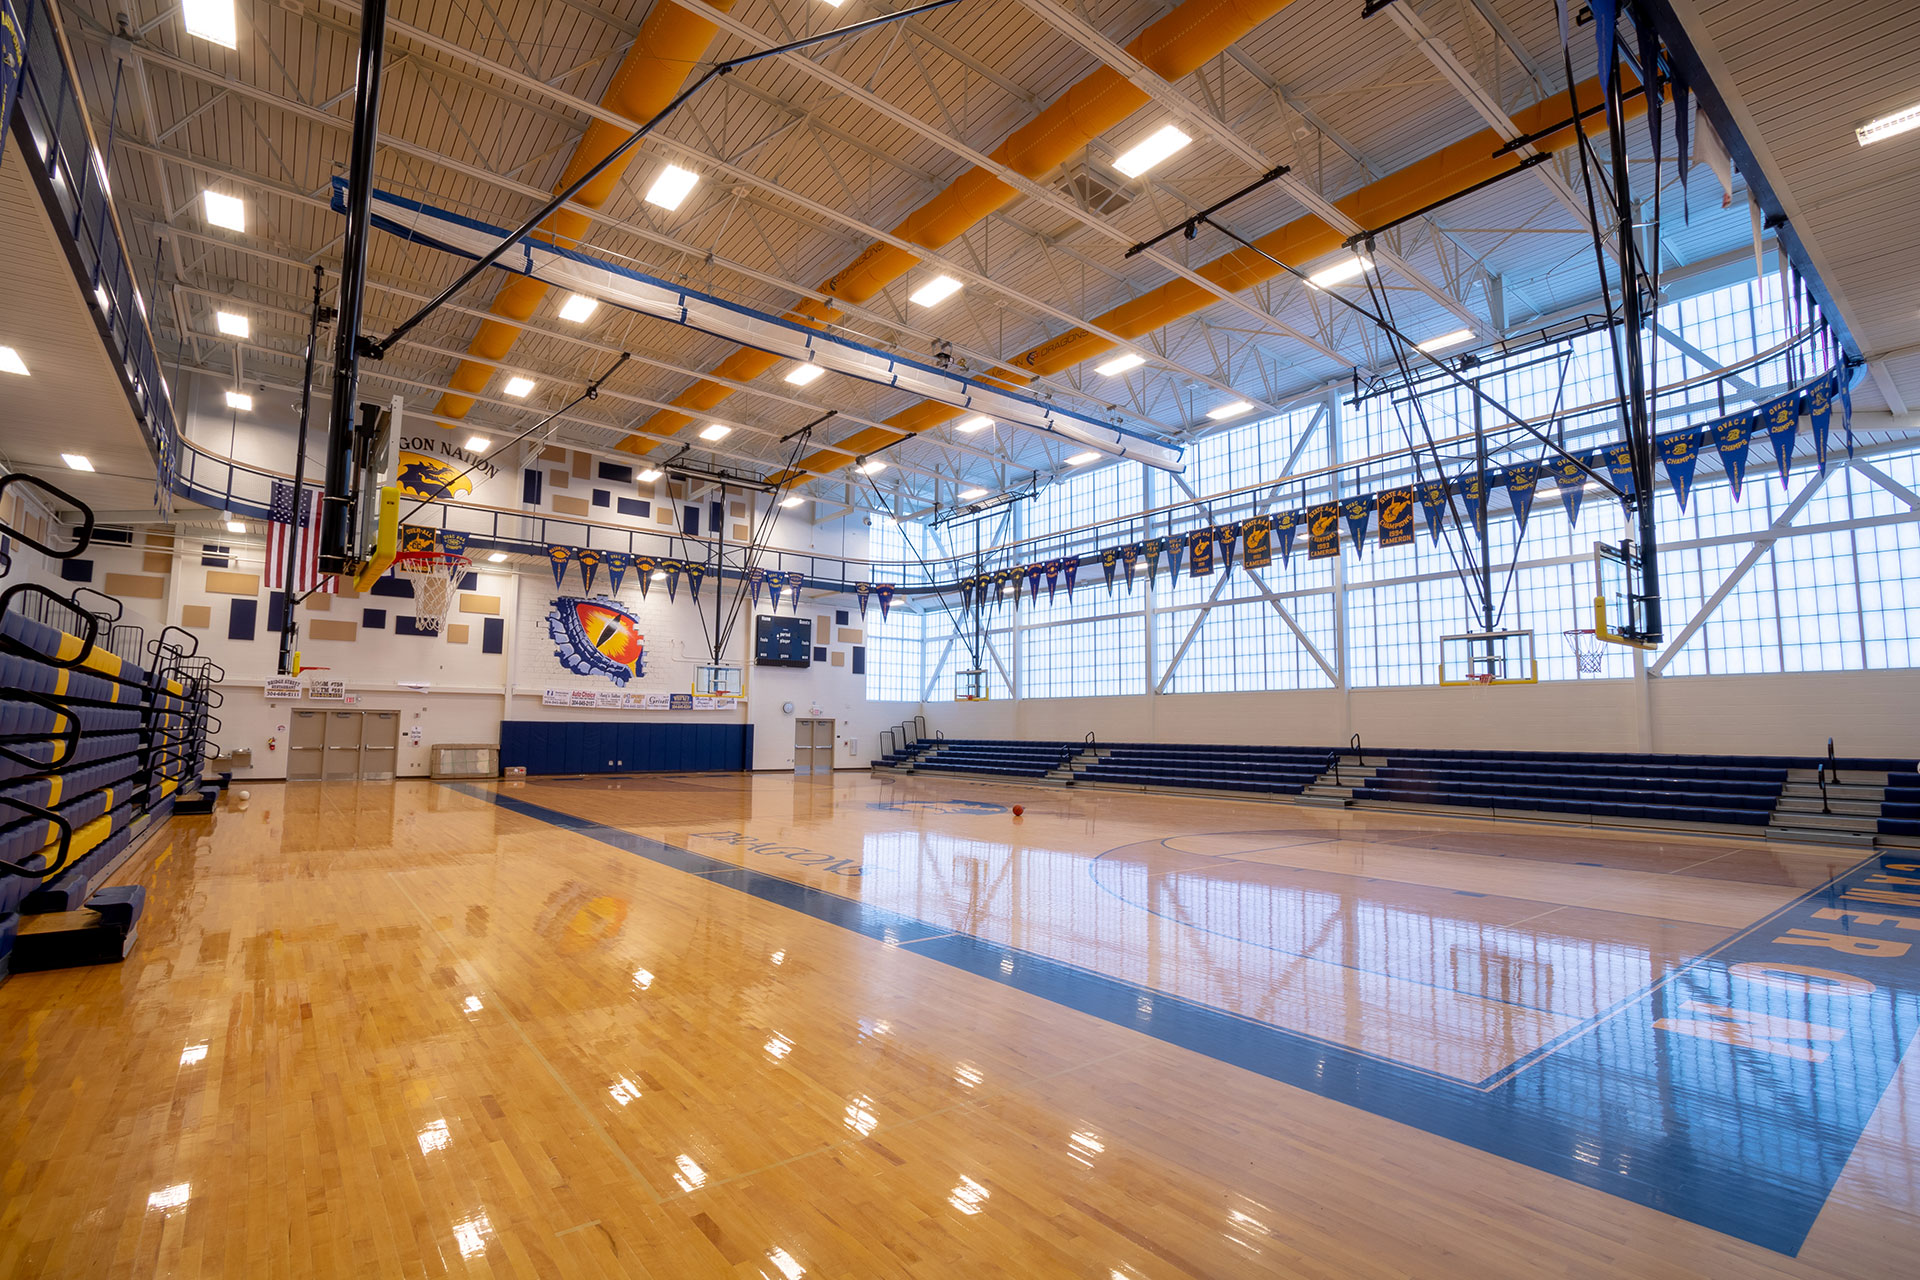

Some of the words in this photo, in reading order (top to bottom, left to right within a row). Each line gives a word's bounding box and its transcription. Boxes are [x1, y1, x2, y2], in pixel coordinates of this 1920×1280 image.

[1041, 330, 1090, 356] DRAGONS
[1769, 400, 1786, 415] OVAC
[1717, 418, 1739, 432] OVAC
[1771, 420, 1794, 433] CHAMPS
[1664, 434, 1686, 445] OVAC
[1721, 439, 1747, 452] CHAMPS
[400, 437, 434, 451] GON
[440, 441, 500, 479] NATION
[1666, 453, 1695, 464] CHAMPS
[1559, 474, 1585, 484] CHAMPS
[1380, 491, 1396, 504] STATE
[1309, 506, 1324, 518] STATE
[1243, 520, 1256, 530] STATE
[1379, 515, 1412, 530] CHAMPIONS
[1382, 535, 1411, 545] CAMERON
[1310, 548, 1337, 557] CAMERON
[690, 830, 871, 877] DRAGONS
